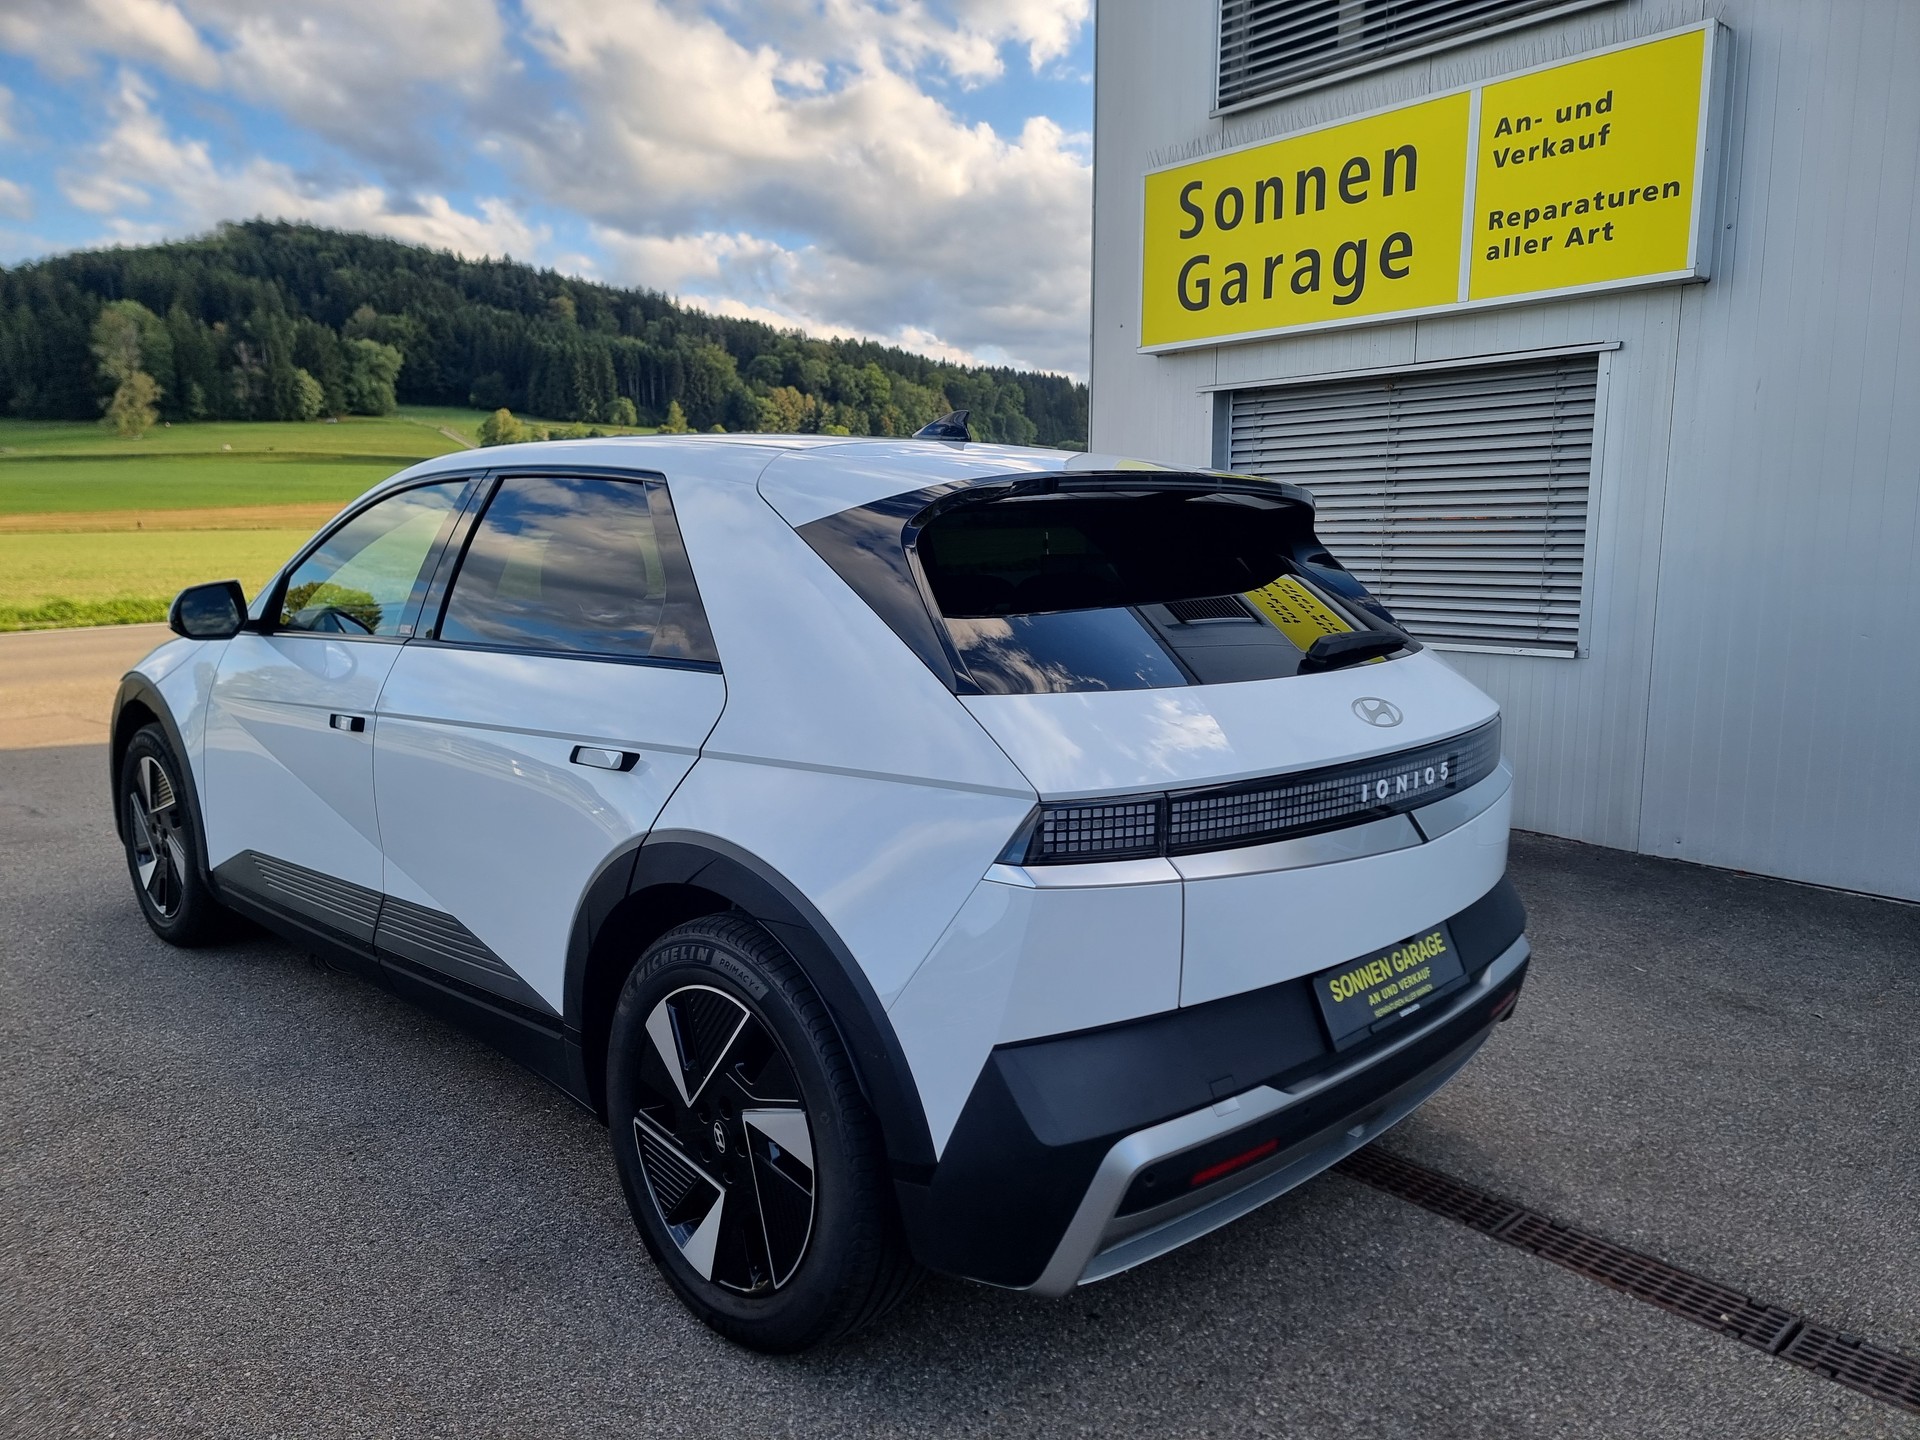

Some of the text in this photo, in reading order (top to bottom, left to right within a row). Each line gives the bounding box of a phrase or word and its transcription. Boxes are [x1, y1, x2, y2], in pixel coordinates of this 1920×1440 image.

[1493, 90, 1613, 139] An- und
[1492, 122, 1611, 169] Verkauf
[1179, 143, 1418, 240] Sonnen
[1488, 180, 1681, 231] Reparaturen
[1486, 221, 1614, 262] aller Art
[1177, 231, 1413, 312] Garage
[636, 946, 710, 985] MICHELIN
[719, 957, 754, 988] PRIMACY
[1329, 931, 1447, 1003] SONNEN GARAGE
[1368, 966, 1431, 1006] AN UND VERKAUF
